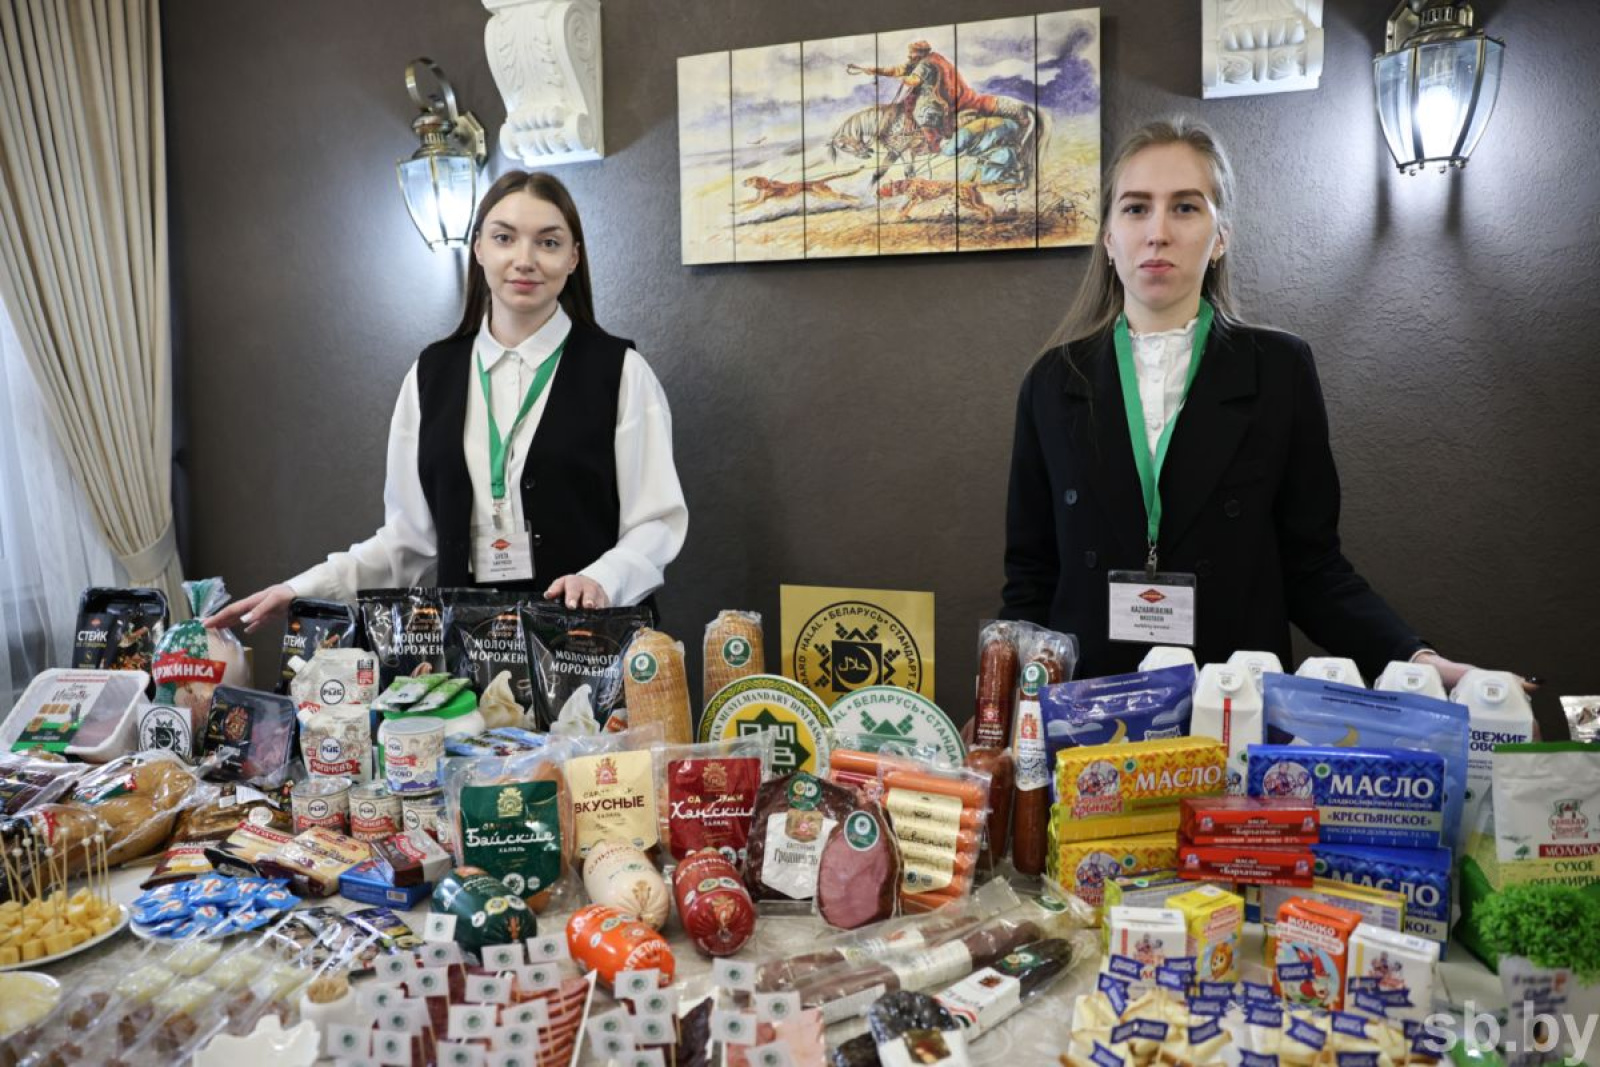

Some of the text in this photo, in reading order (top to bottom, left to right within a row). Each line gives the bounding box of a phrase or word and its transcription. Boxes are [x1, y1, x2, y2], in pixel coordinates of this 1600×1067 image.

[828, 607, 884, 624] БЕЛАРУСЬ
[78, 629, 109, 642] СТЕЙК
[800, 621, 823, 651] HALAL
[555, 650, 620, 665] МОЛОЧНОГО
[888, 622, 917, 677] СТАНДАРТ
[853, 693, 920, 714] БЕЛАРУСЬ
[1469, 730, 1528, 744] ВЕЖИЕ
[1135, 765, 1222, 792] МАСЛО
[1330, 775, 1435, 799] МАСЛО
[574, 795, 645, 814] ВКУСНЫЕ
[1328, 811, 1433, 826] «КРЕСТЬЯНСКОЕ»
[1554, 861, 1595, 873] СУХОЕ
